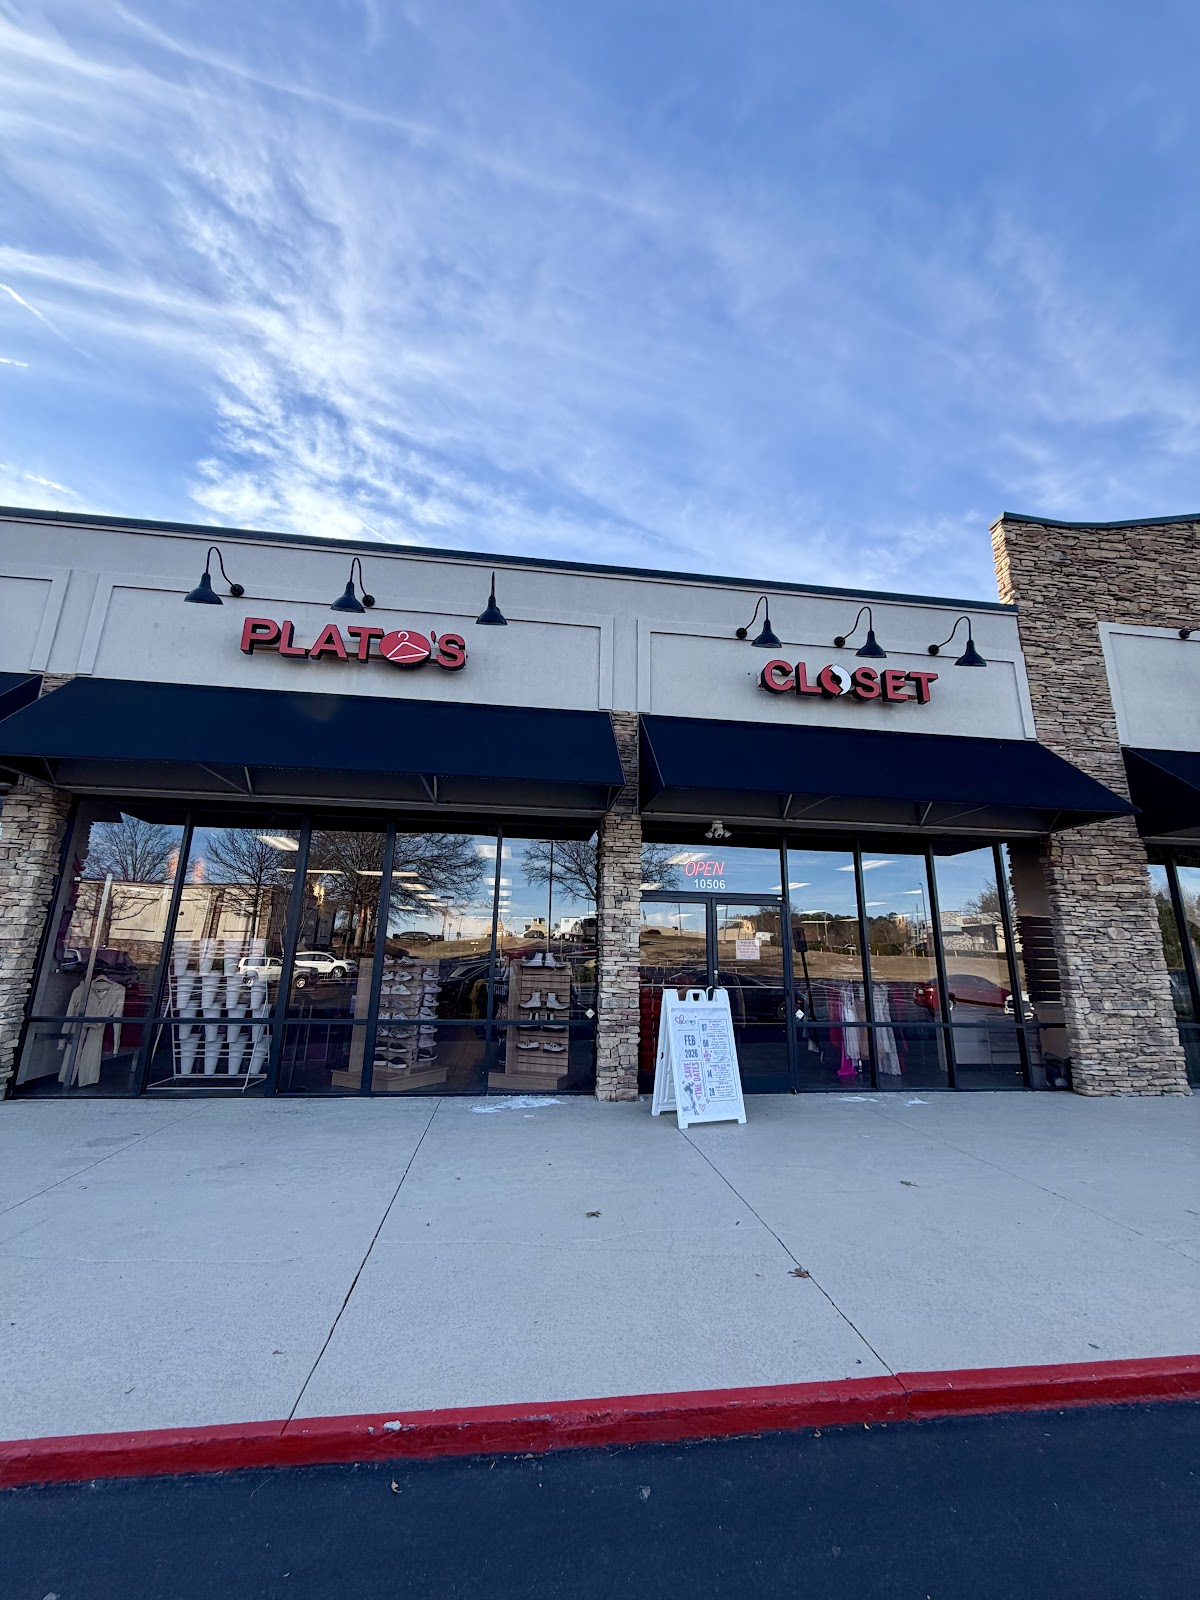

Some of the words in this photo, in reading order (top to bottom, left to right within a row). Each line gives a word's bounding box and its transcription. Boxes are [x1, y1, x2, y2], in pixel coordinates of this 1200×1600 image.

[240, 617, 466, 671] PLATO'S
[761, 659, 938, 704] CLOSET
[685, 861, 724, 876] OPEN
[693, 879, 726, 889] 10506
[684, 1035, 695, 1046] FEB
[685, 1049, 698, 1059] 2026
[684, 1062, 692, 1078] SAVE
[692, 1062, 701, 1081] DATES
[707, 1070, 712, 1078] 14
[695, 1083, 703, 1096] THE
[709, 1088, 715, 1096] 28
